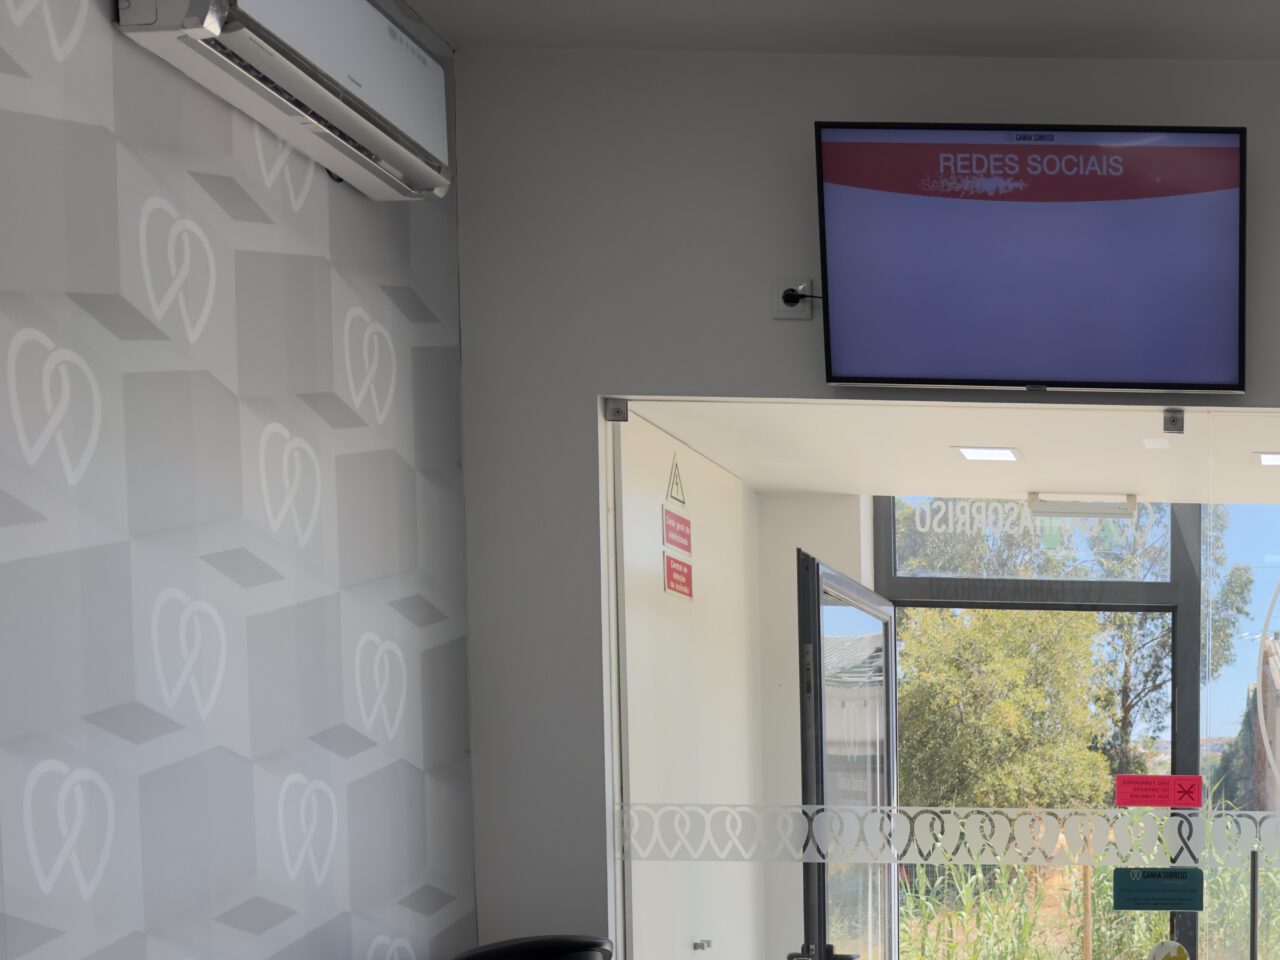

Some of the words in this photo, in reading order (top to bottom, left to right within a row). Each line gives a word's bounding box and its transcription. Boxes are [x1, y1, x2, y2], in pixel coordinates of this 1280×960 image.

[938, 153, 1020, 175] REDES
[1026, 154, 1125, 177] SOCIAIS
[1142, 870, 1162, 880] GANHA
[1162, 870, 1188, 880] SORRISO
